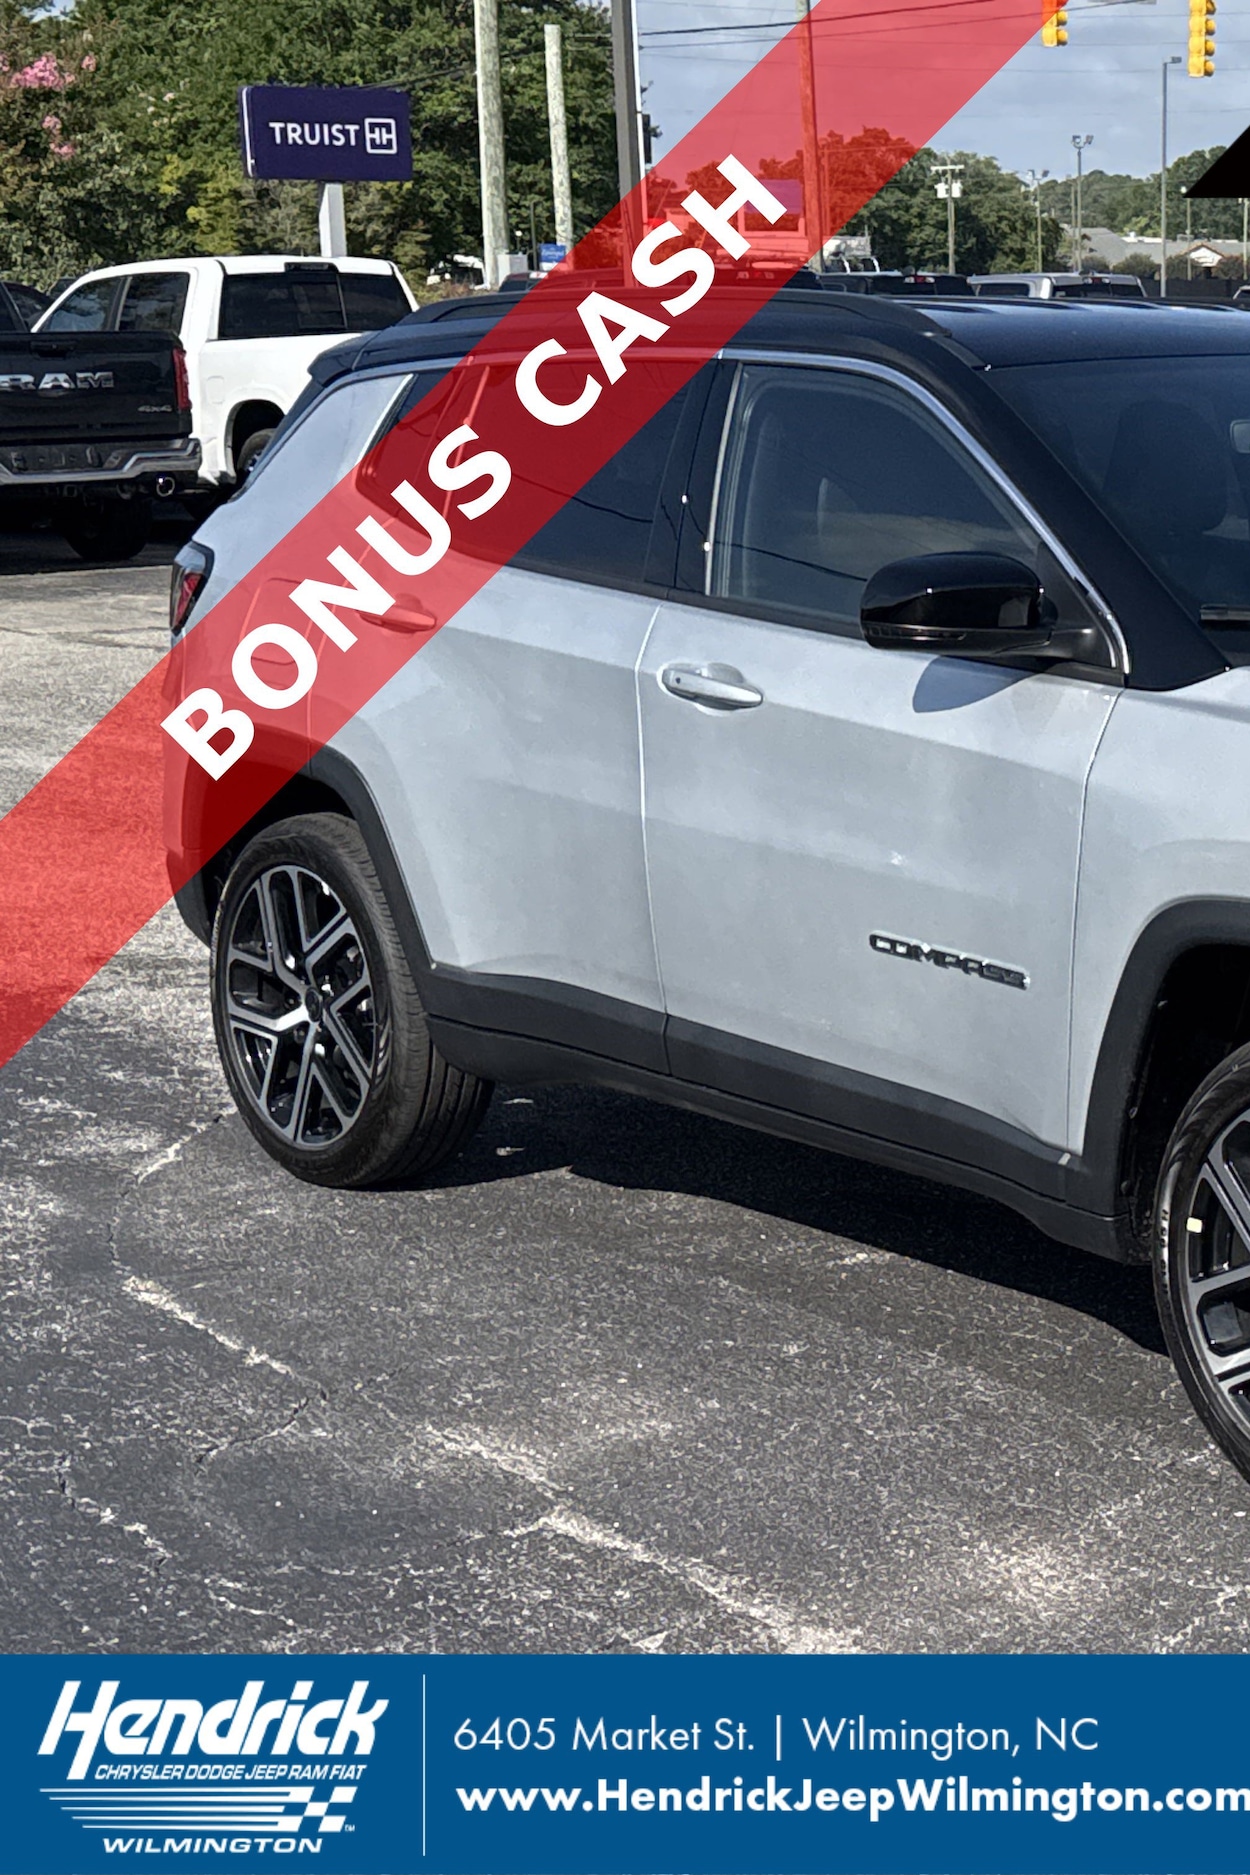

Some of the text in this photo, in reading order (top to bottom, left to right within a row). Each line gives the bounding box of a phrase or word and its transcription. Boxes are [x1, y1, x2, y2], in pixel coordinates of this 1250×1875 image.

[268, 121, 360, 147] TRUIST
[0, 371, 115, 392] RAM
[869, 930, 1031, 991] COMPASS
